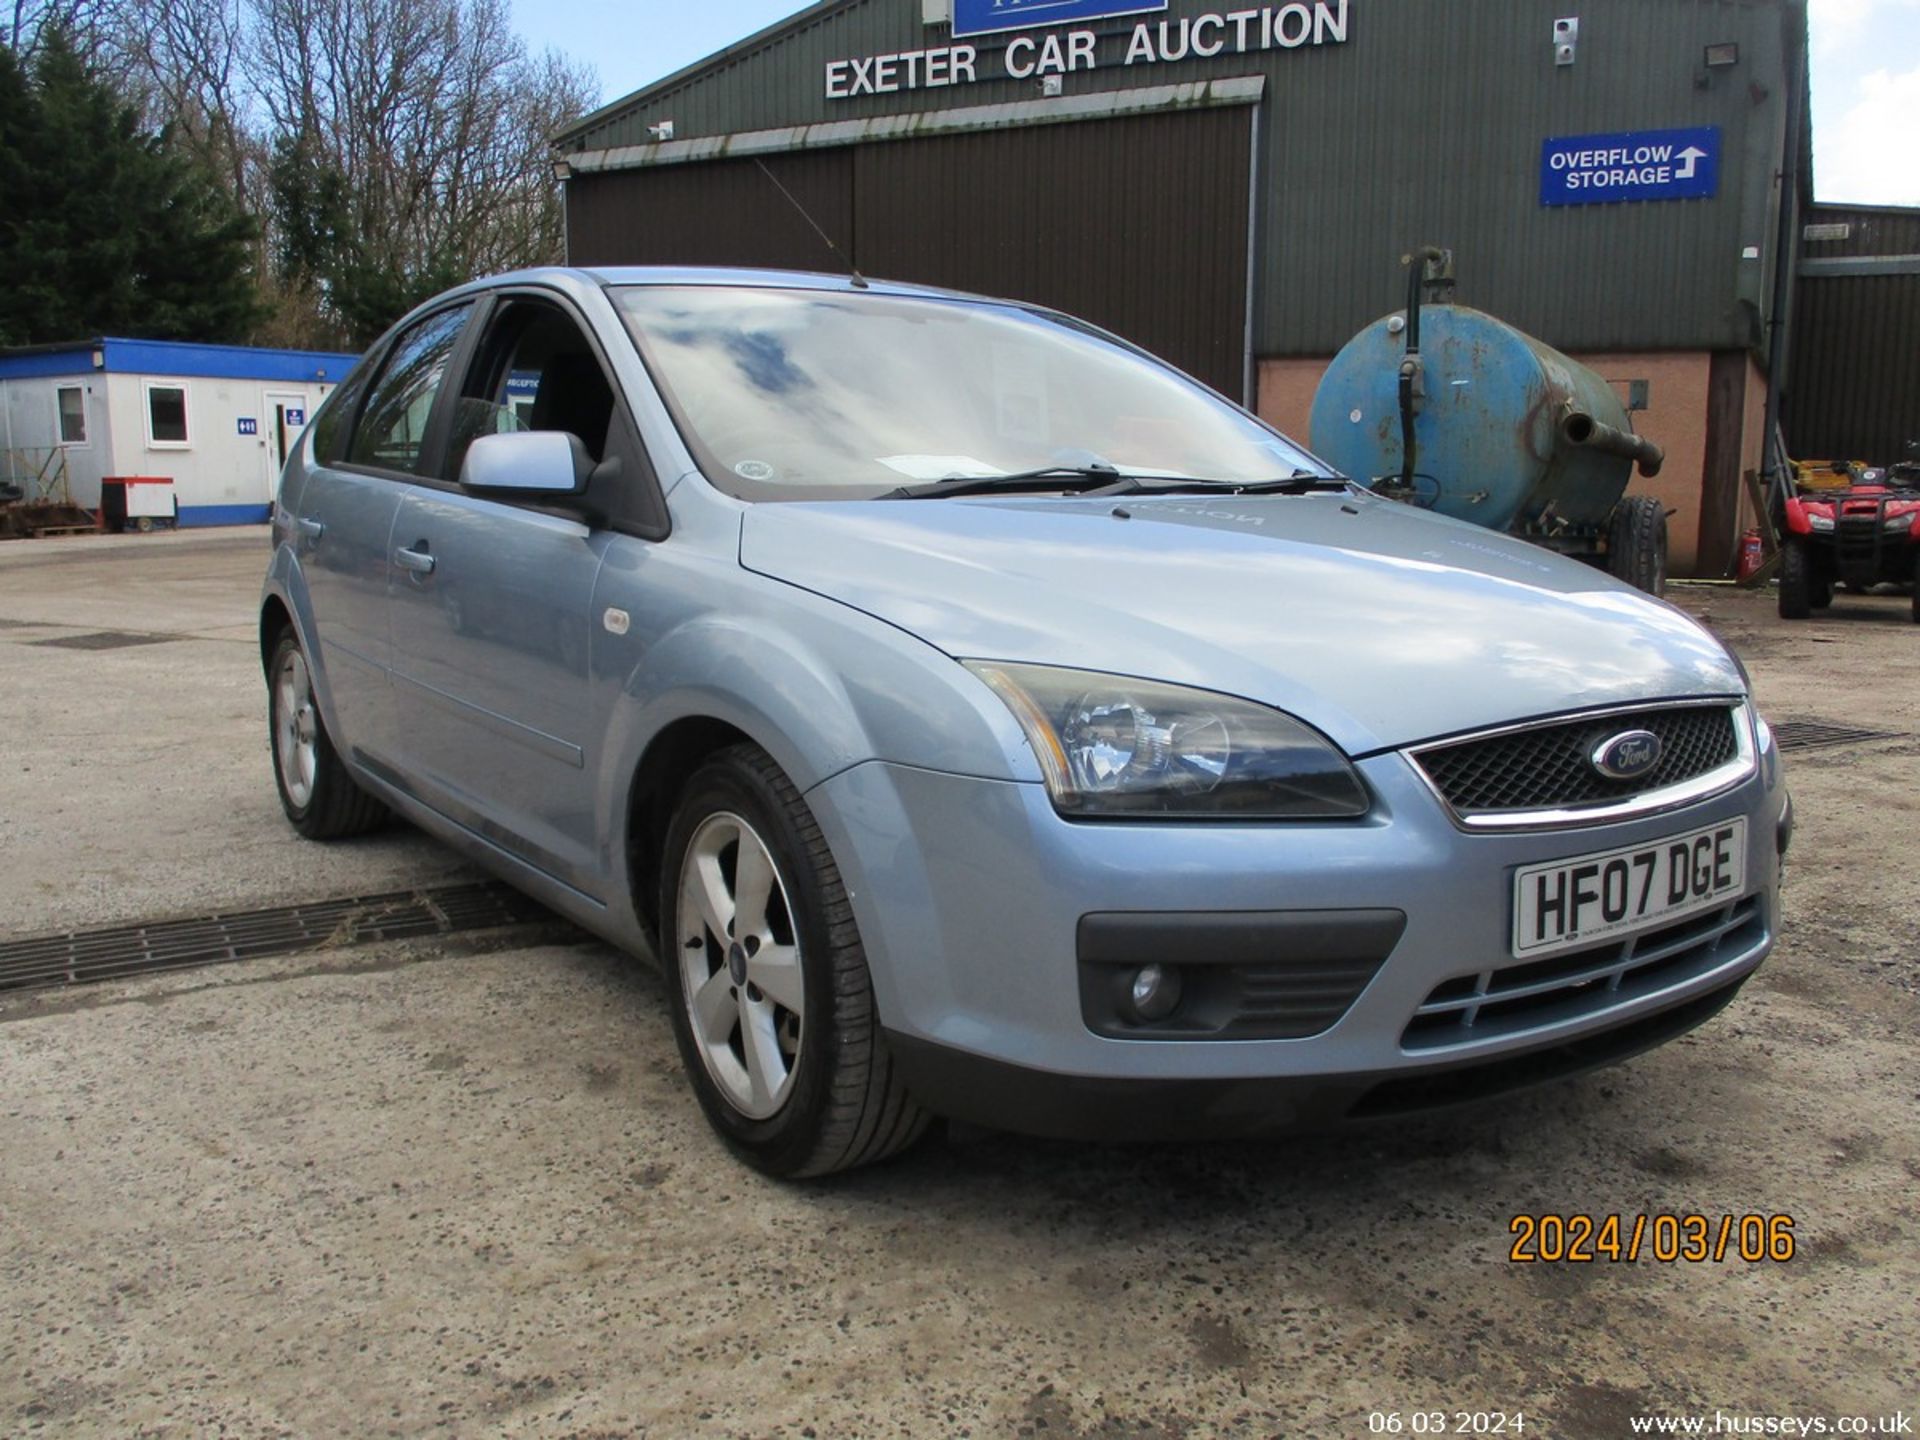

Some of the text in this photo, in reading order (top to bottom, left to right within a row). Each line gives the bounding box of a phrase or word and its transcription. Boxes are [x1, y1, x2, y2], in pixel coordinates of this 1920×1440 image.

[826, 0, 1347, 98] EXETER CAR AUCTION
[1549, 145, 1673, 169] OVERFLOW
[1566, 166, 1671, 189] STORAGE
[1618, 740, 1651, 769] Ford
[1536, 850, 1657, 940] HF07
[1667, 827, 1734, 906] DGE
